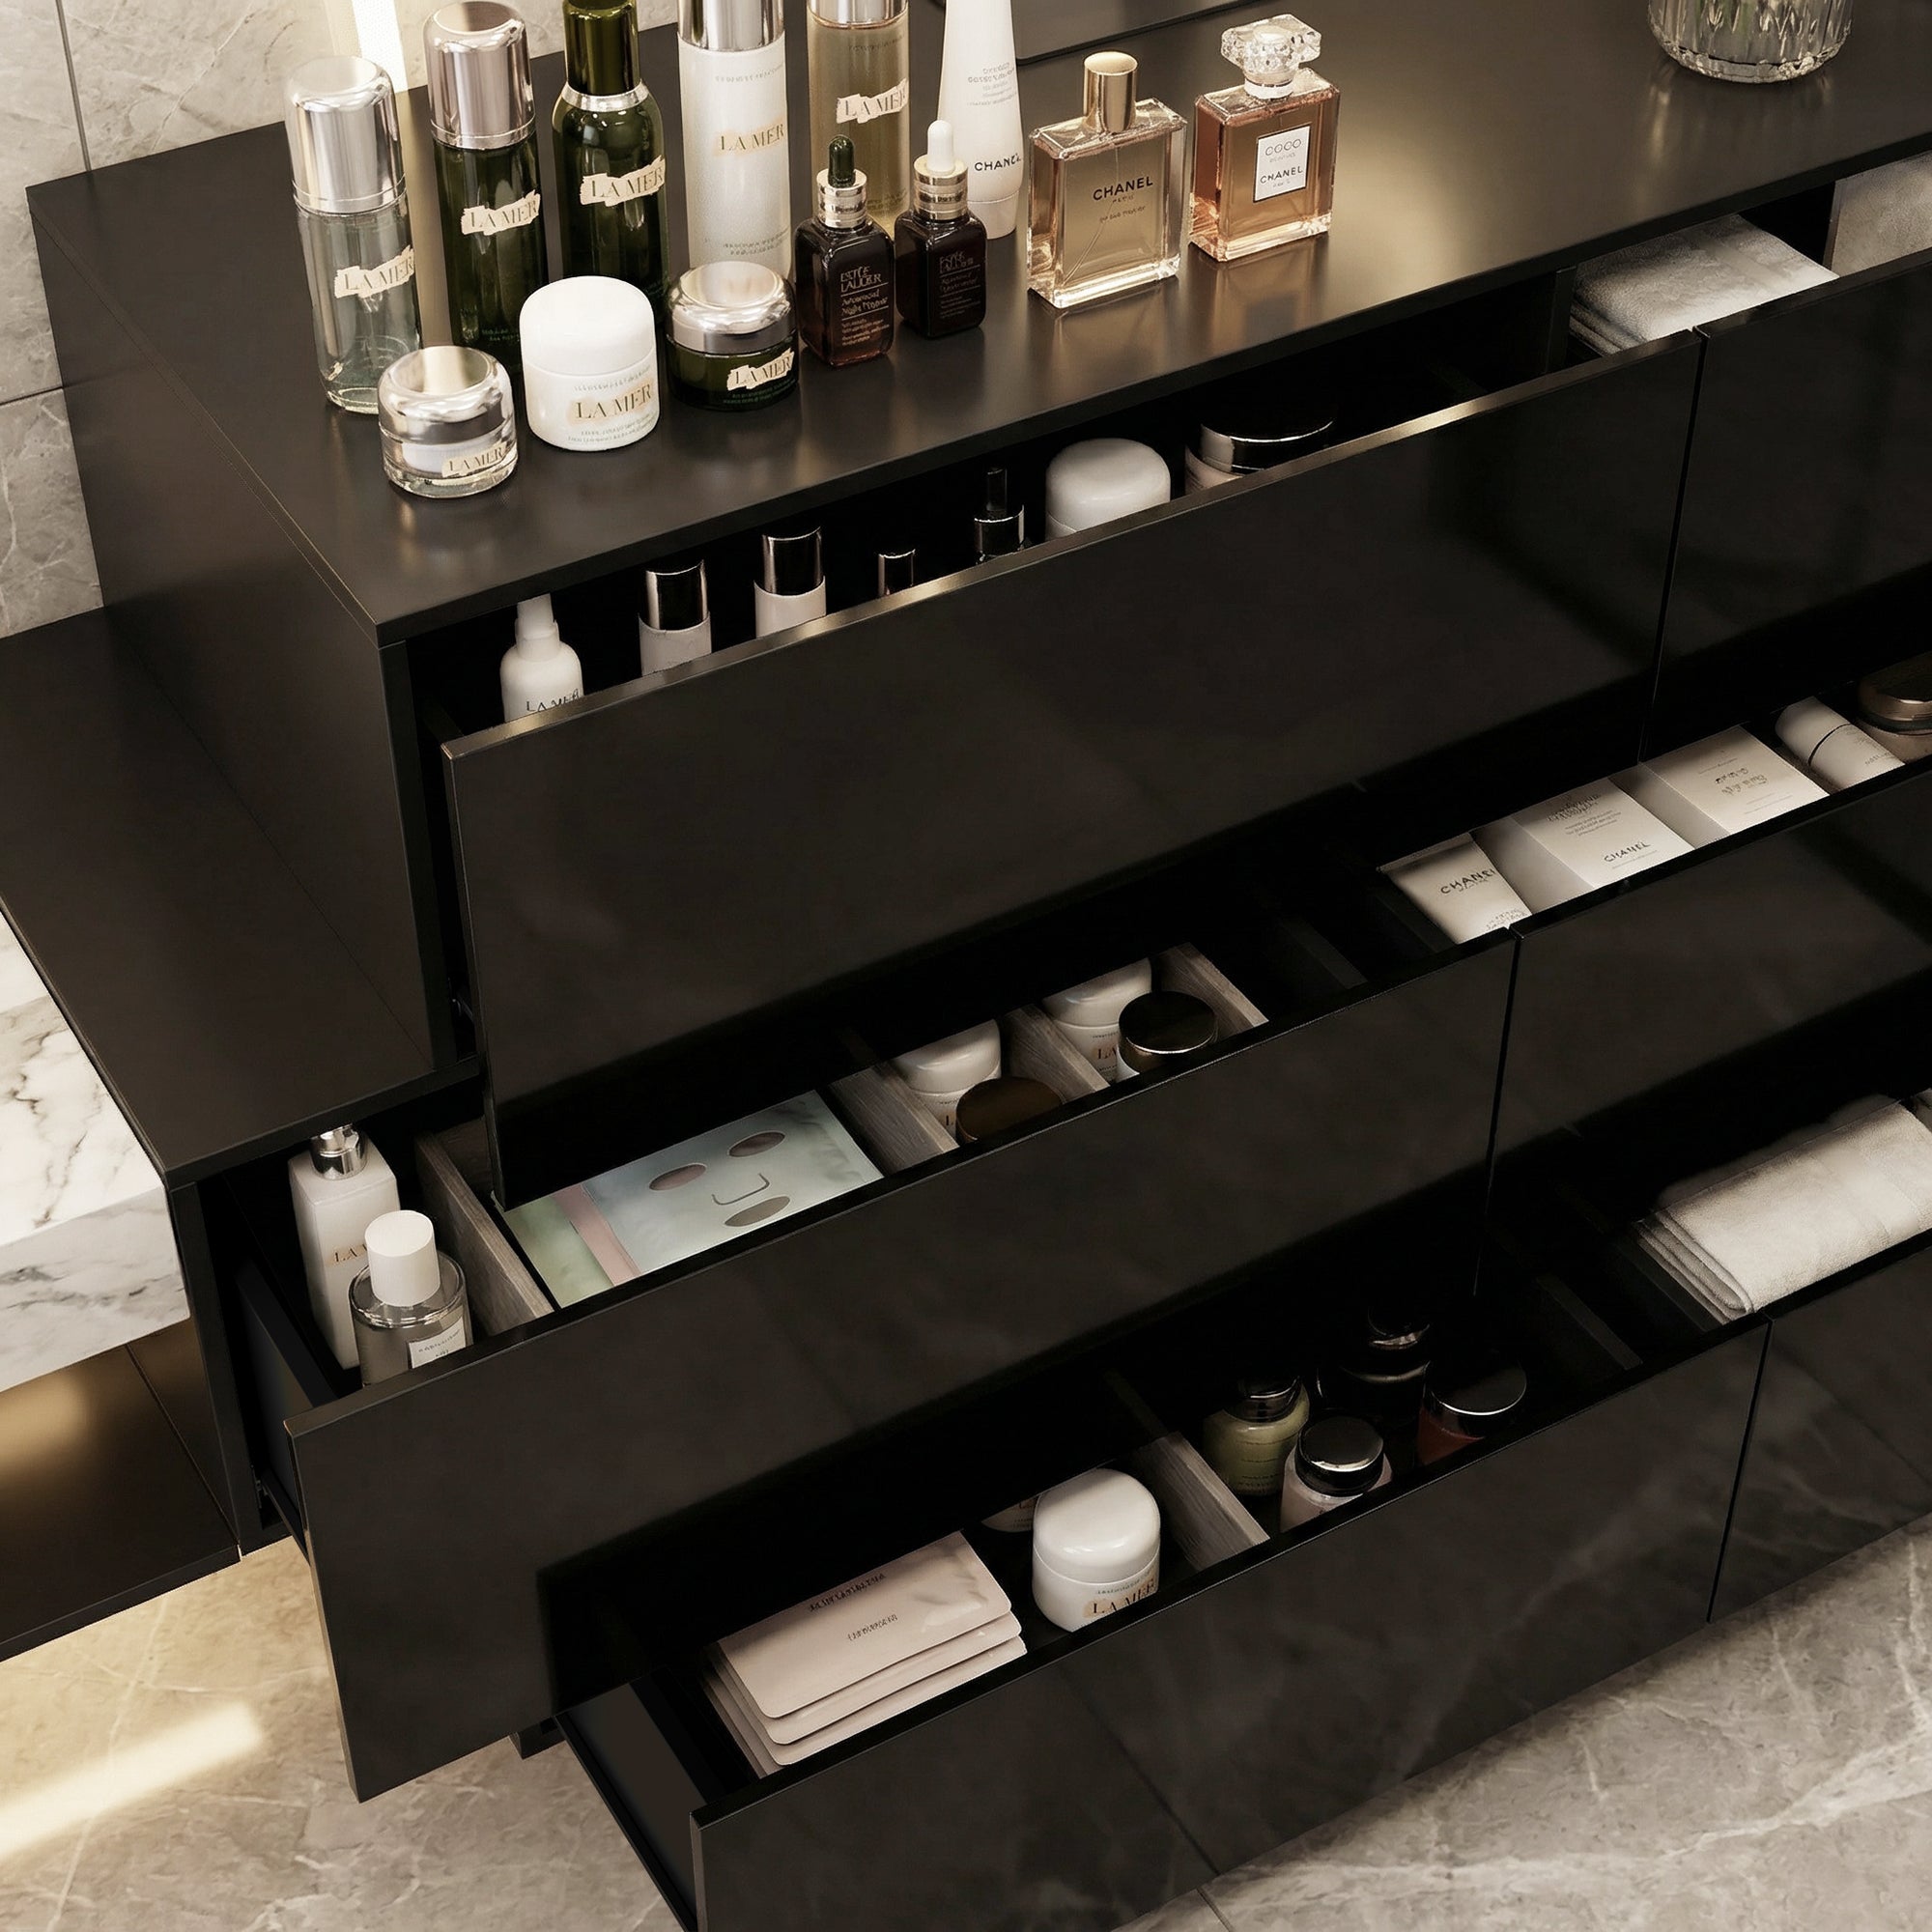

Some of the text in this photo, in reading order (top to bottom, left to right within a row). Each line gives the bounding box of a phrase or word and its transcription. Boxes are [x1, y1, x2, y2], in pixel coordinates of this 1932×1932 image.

[719, 123, 785, 152] LA MER
[1264, 138, 1302, 156] COCO
[590, 166, 664, 198] LA MER
[1260, 165, 1304, 185] CHANEL
[1093, 176, 1154, 202] CHANEL
[469, 199, 538, 228] LA MER
[344, 272, 374, 291] LA
[734, 370, 758, 385] LA
[576, 384, 652, 419] LA MER
[448, 459, 471, 471] LA
[526, 700, 548, 712] LA
